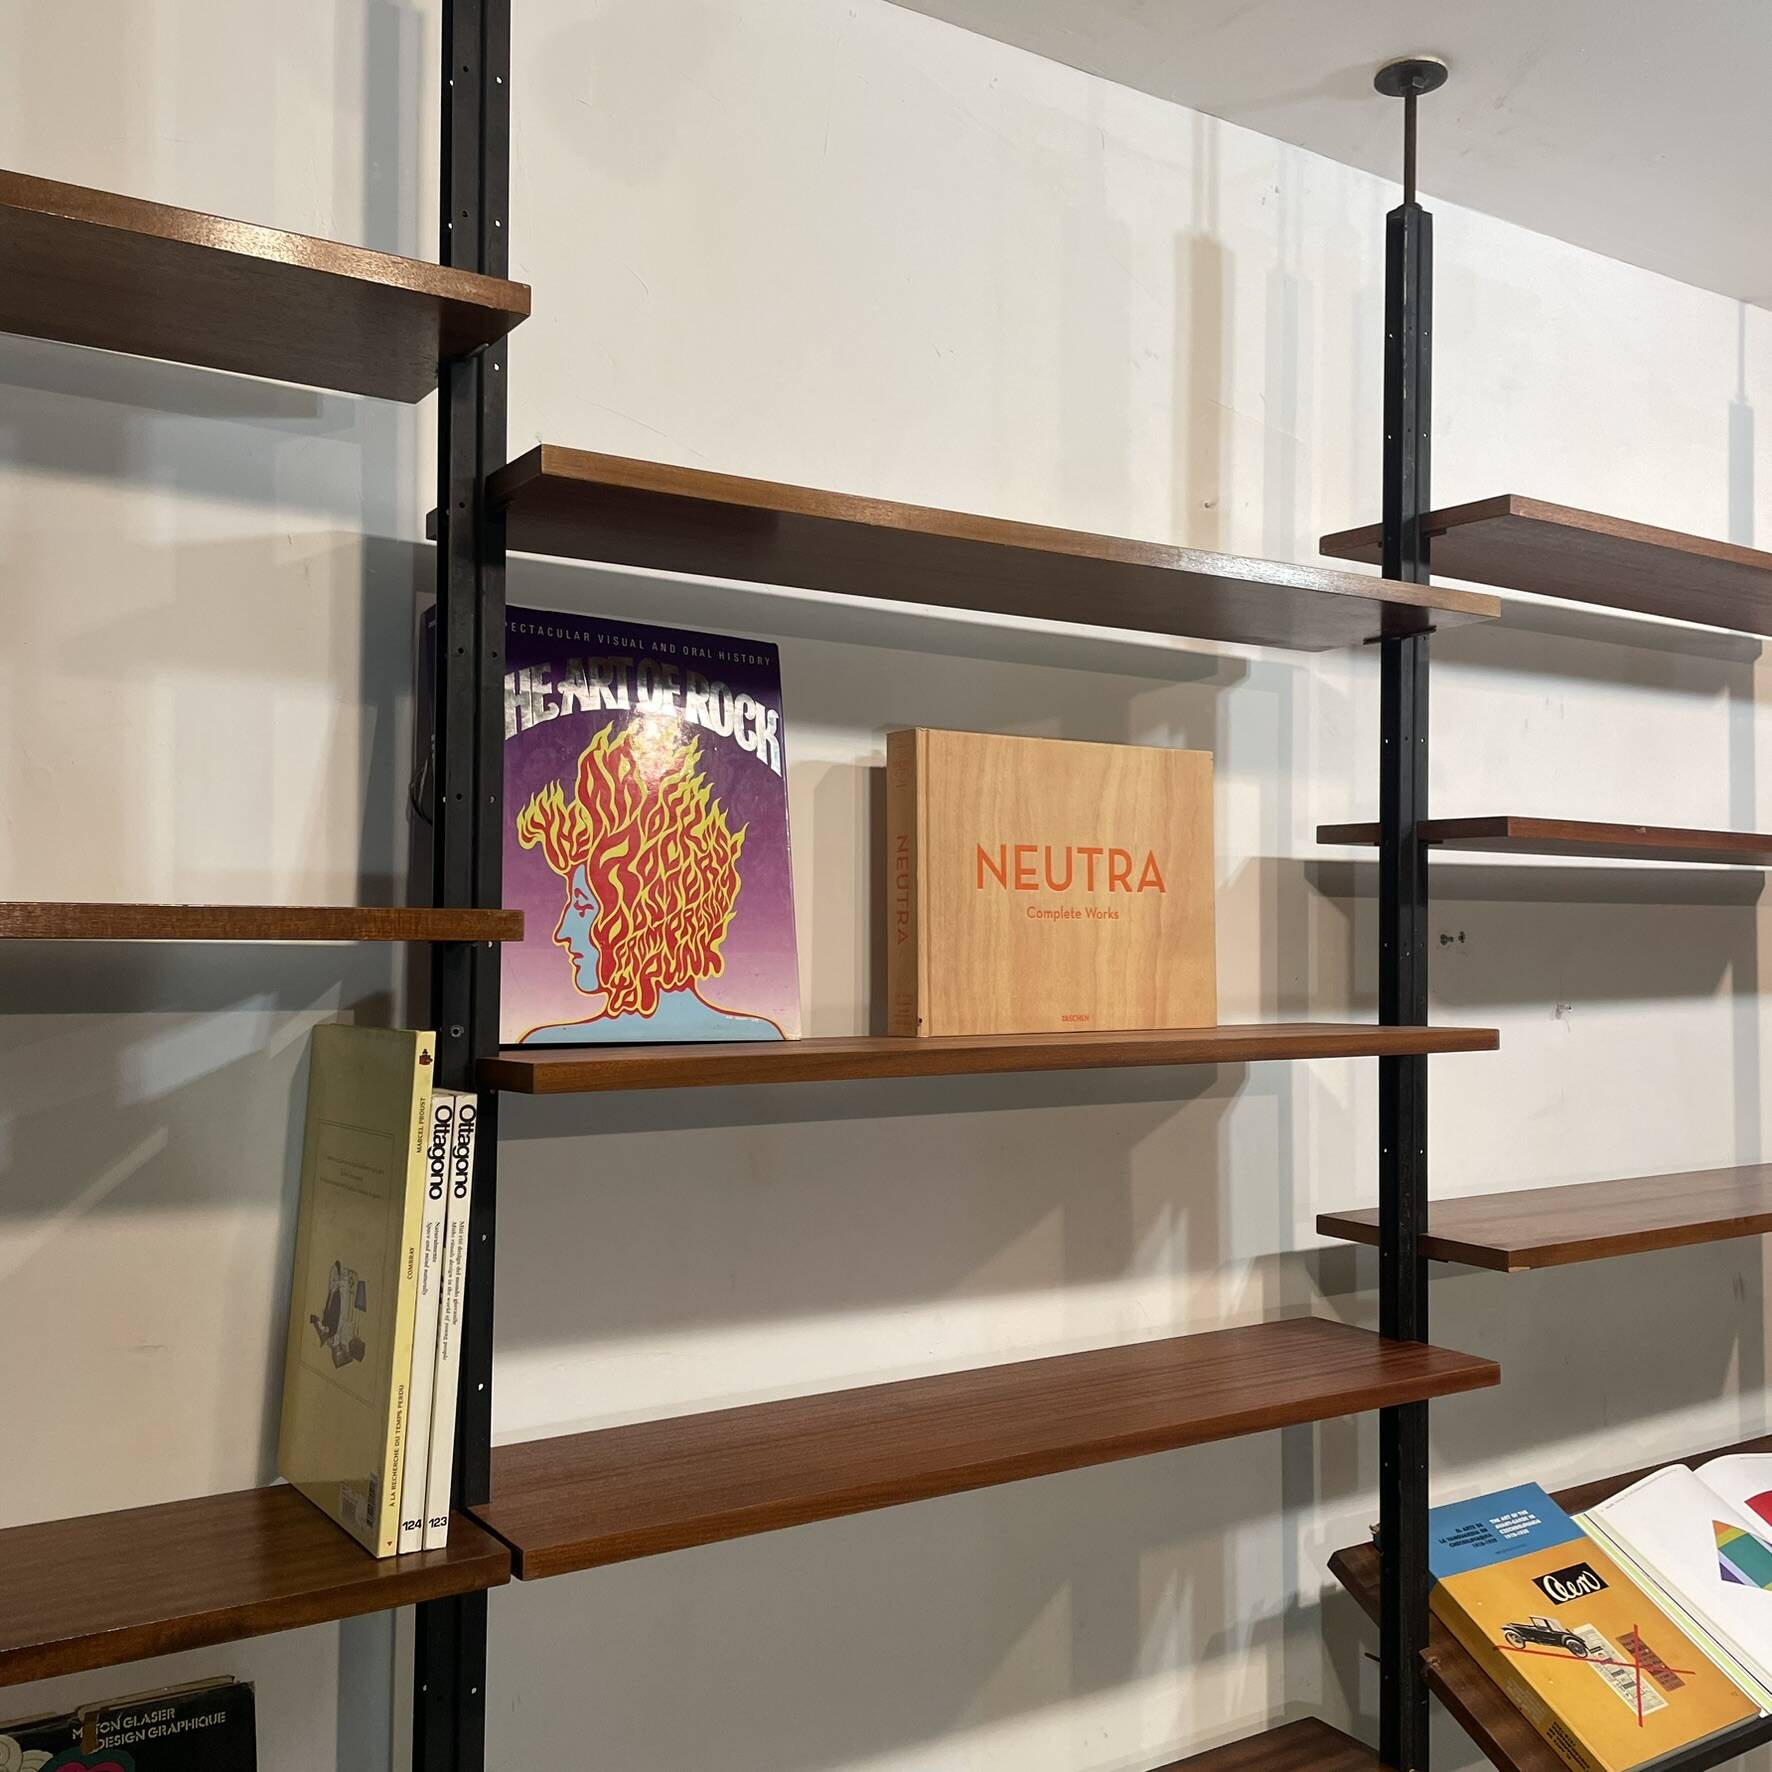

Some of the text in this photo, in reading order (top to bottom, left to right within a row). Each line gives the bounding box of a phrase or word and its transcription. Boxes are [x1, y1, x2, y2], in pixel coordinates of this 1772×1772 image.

[505, 621, 772, 666] ECTACULAR VISUAL AND ORAL HISTORY
[504, 656, 783, 778] HE ART OF ROCK
[976, 842, 1167, 894] NEUTRA
[895, 834, 910, 945] NEUTRA
[1026, 905, 1120, 922] Complete Works
[1061, 1014, 1090, 1023] TASCHEN
[416, 1097, 427, 1154] MARCEL PROUST
[427, 1104, 453, 1200] Ottagono
[452, 1104, 477, 1199] Ottagono
[406, 1247, 415, 1280] COMBRAY
[397, 1384, 405, 1409] PERDU
[395, 1409, 403, 1434] TEMPS
[394, 1436, 401, 1447] DU
[391, 1449, 400, 1490] RECHERCHE
[402, 1518, 422, 1532] 124
[428, 1516, 448, 1529] 123
[72, 1707, 176, 1741] MTON GLASER
[96, 1711, 227, 1751] DESIGN GRAPHIQUE
